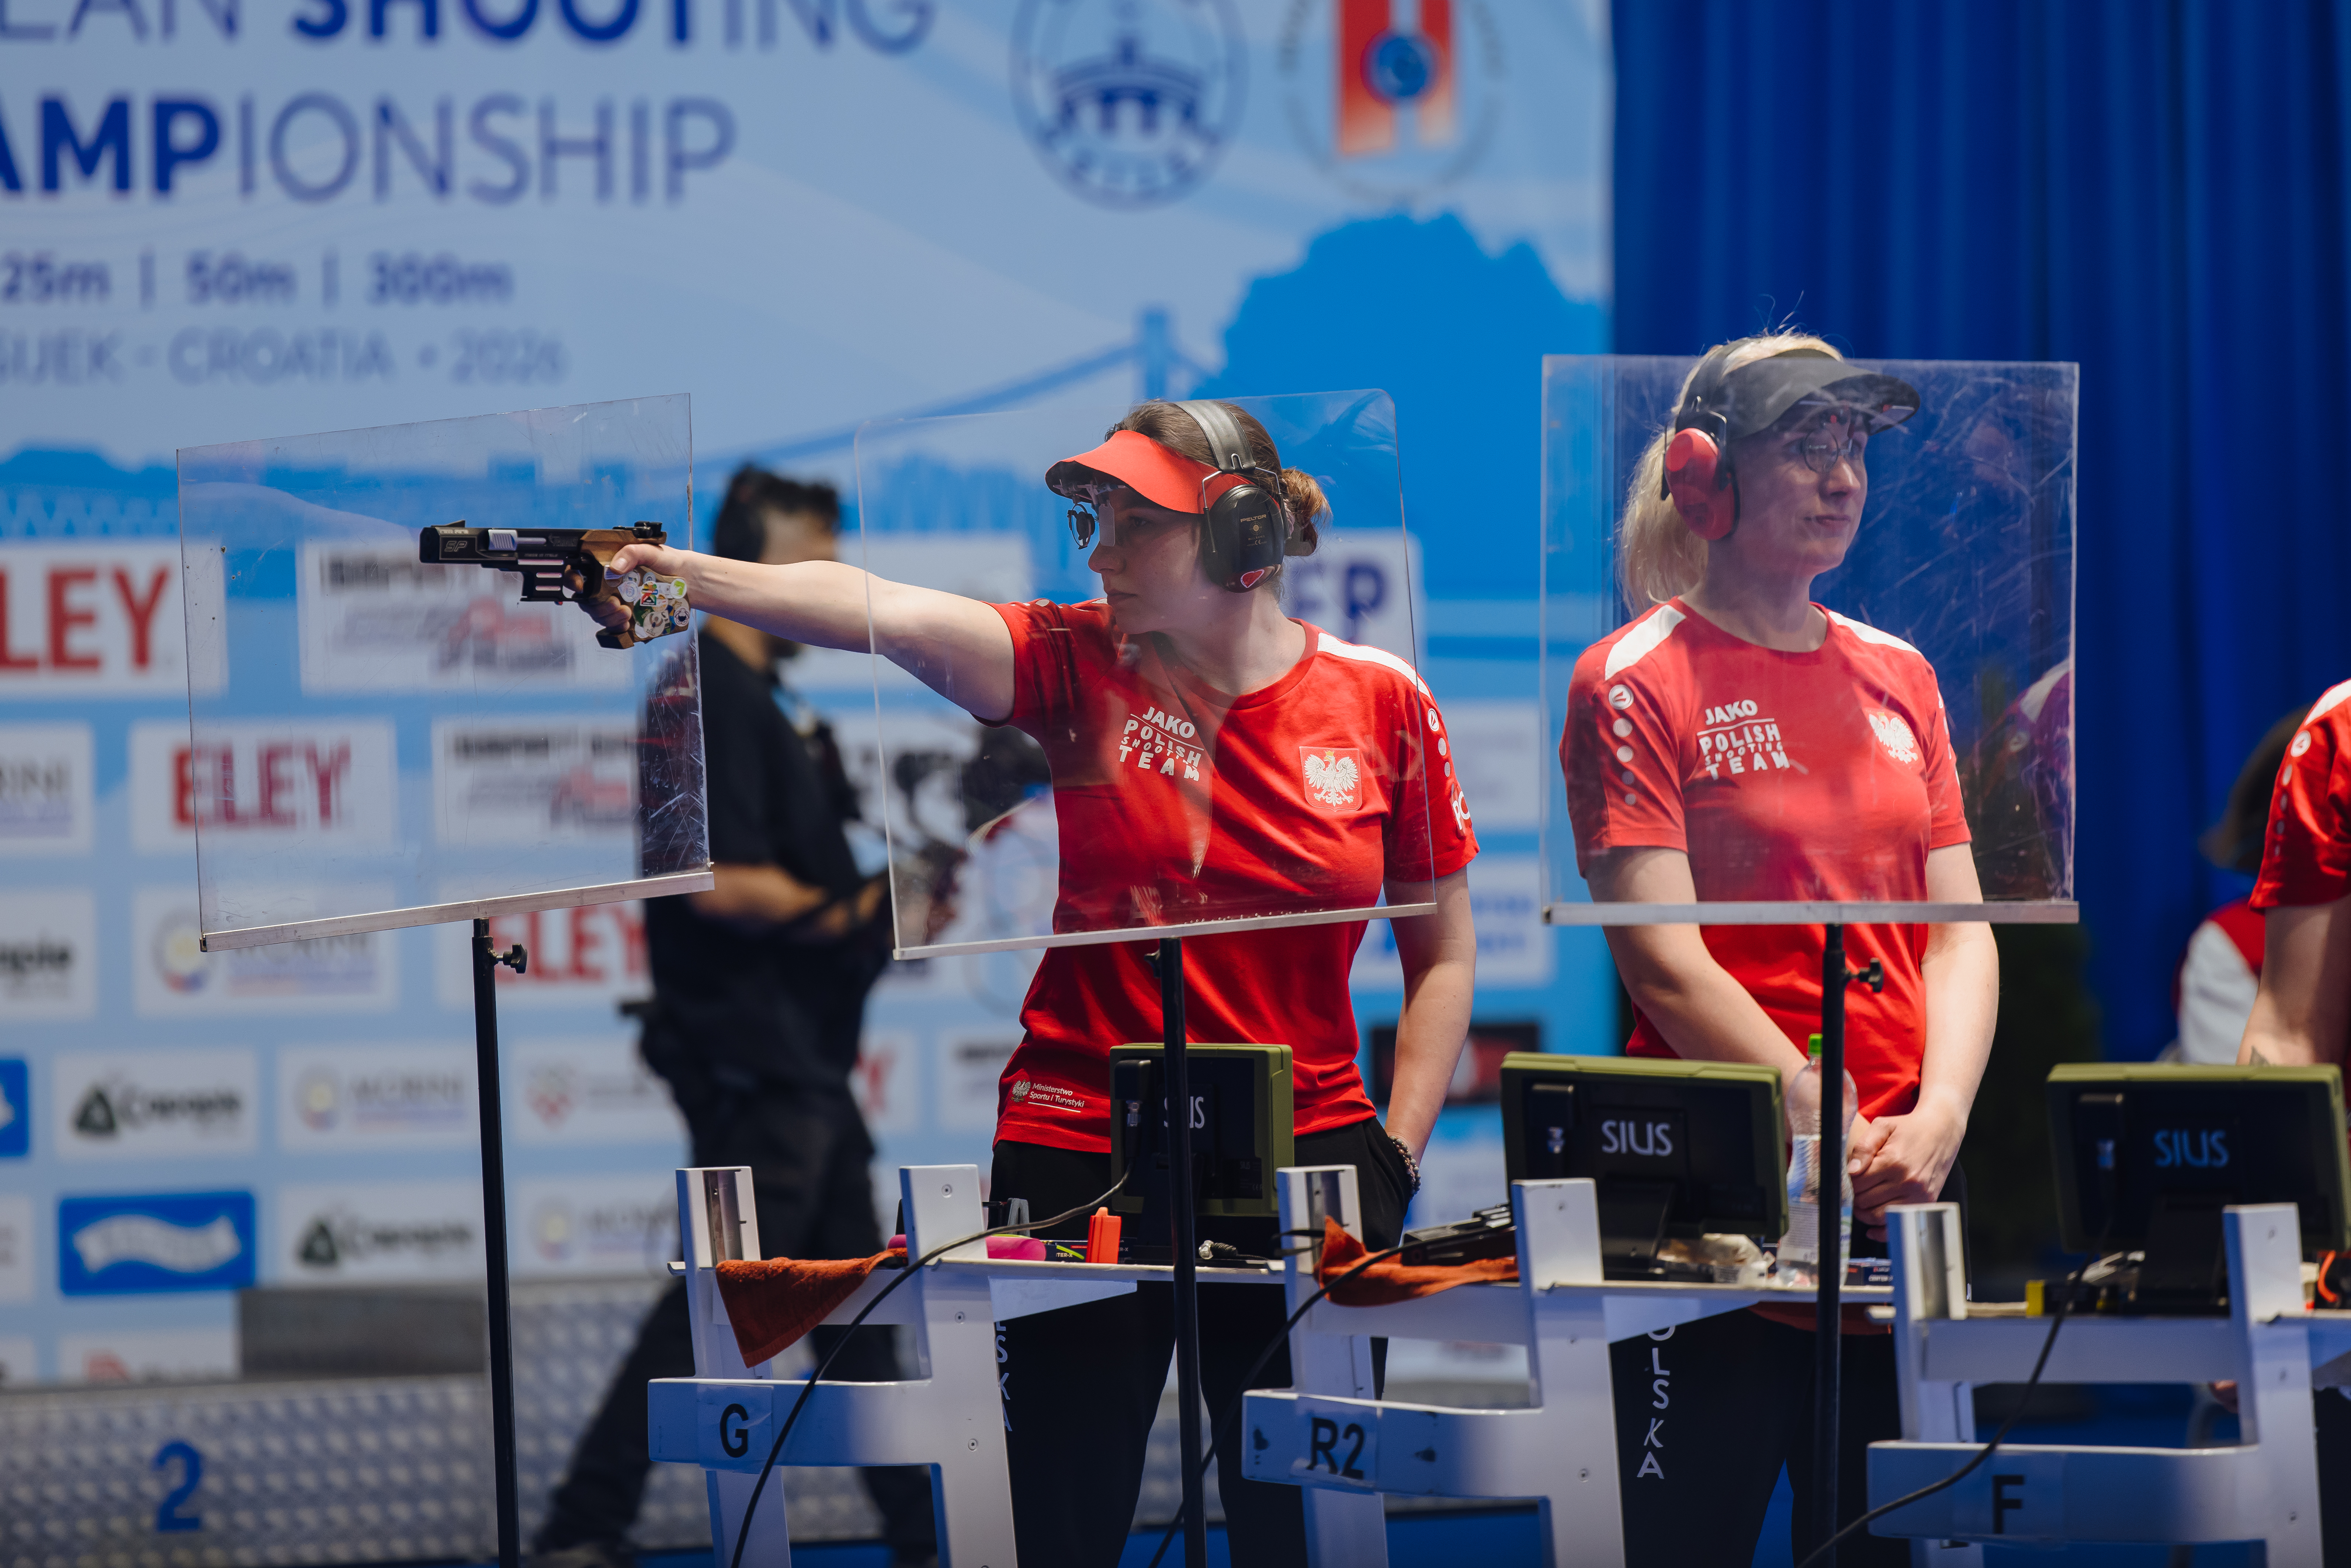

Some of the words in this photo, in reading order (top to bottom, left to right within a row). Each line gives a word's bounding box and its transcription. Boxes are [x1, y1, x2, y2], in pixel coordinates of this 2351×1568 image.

[3, 253, 111, 304] 25m
[186, 251, 297, 305] 50m
[370, 251, 512, 305] 300m
[168, 326, 395, 386] CROATIA
[452, 327, 570, 386] 2026
[1240, 514, 1266, 522] PELTOR
[444, 540, 468, 552] SP
[1142, 706, 1195, 738] JAKO
[1705, 699, 1758, 726] JAKO
[1121, 736, 1197, 771] SHOOT
[1123, 719, 1201, 767] POLISH
[1699, 723, 1781, 756] POLISH
[1705, 741, 1783, 766] SHOOTING
[1119, 745, 1199, 781] TEAM
[1706, 751, 1790, 780] TEAM
[173, 742, 351, 829] ELEY
[1029, 1091, 1050, 1100] Sportu
[1055, 1095, 1085, 1108] Turystyki
[1032, 1083, 1073, 1096] Ministerstwo
[1601, 1119, 1673, 1156] SIUS
[2153, 1129, 2229, 1168] SIUS
[719, 1403, 749, 1458] G
[1306, 1417, 1365, 1479] R2
[154, 1439, 202, 1533] 2
[1993, 1475, 2025, 1534] F
